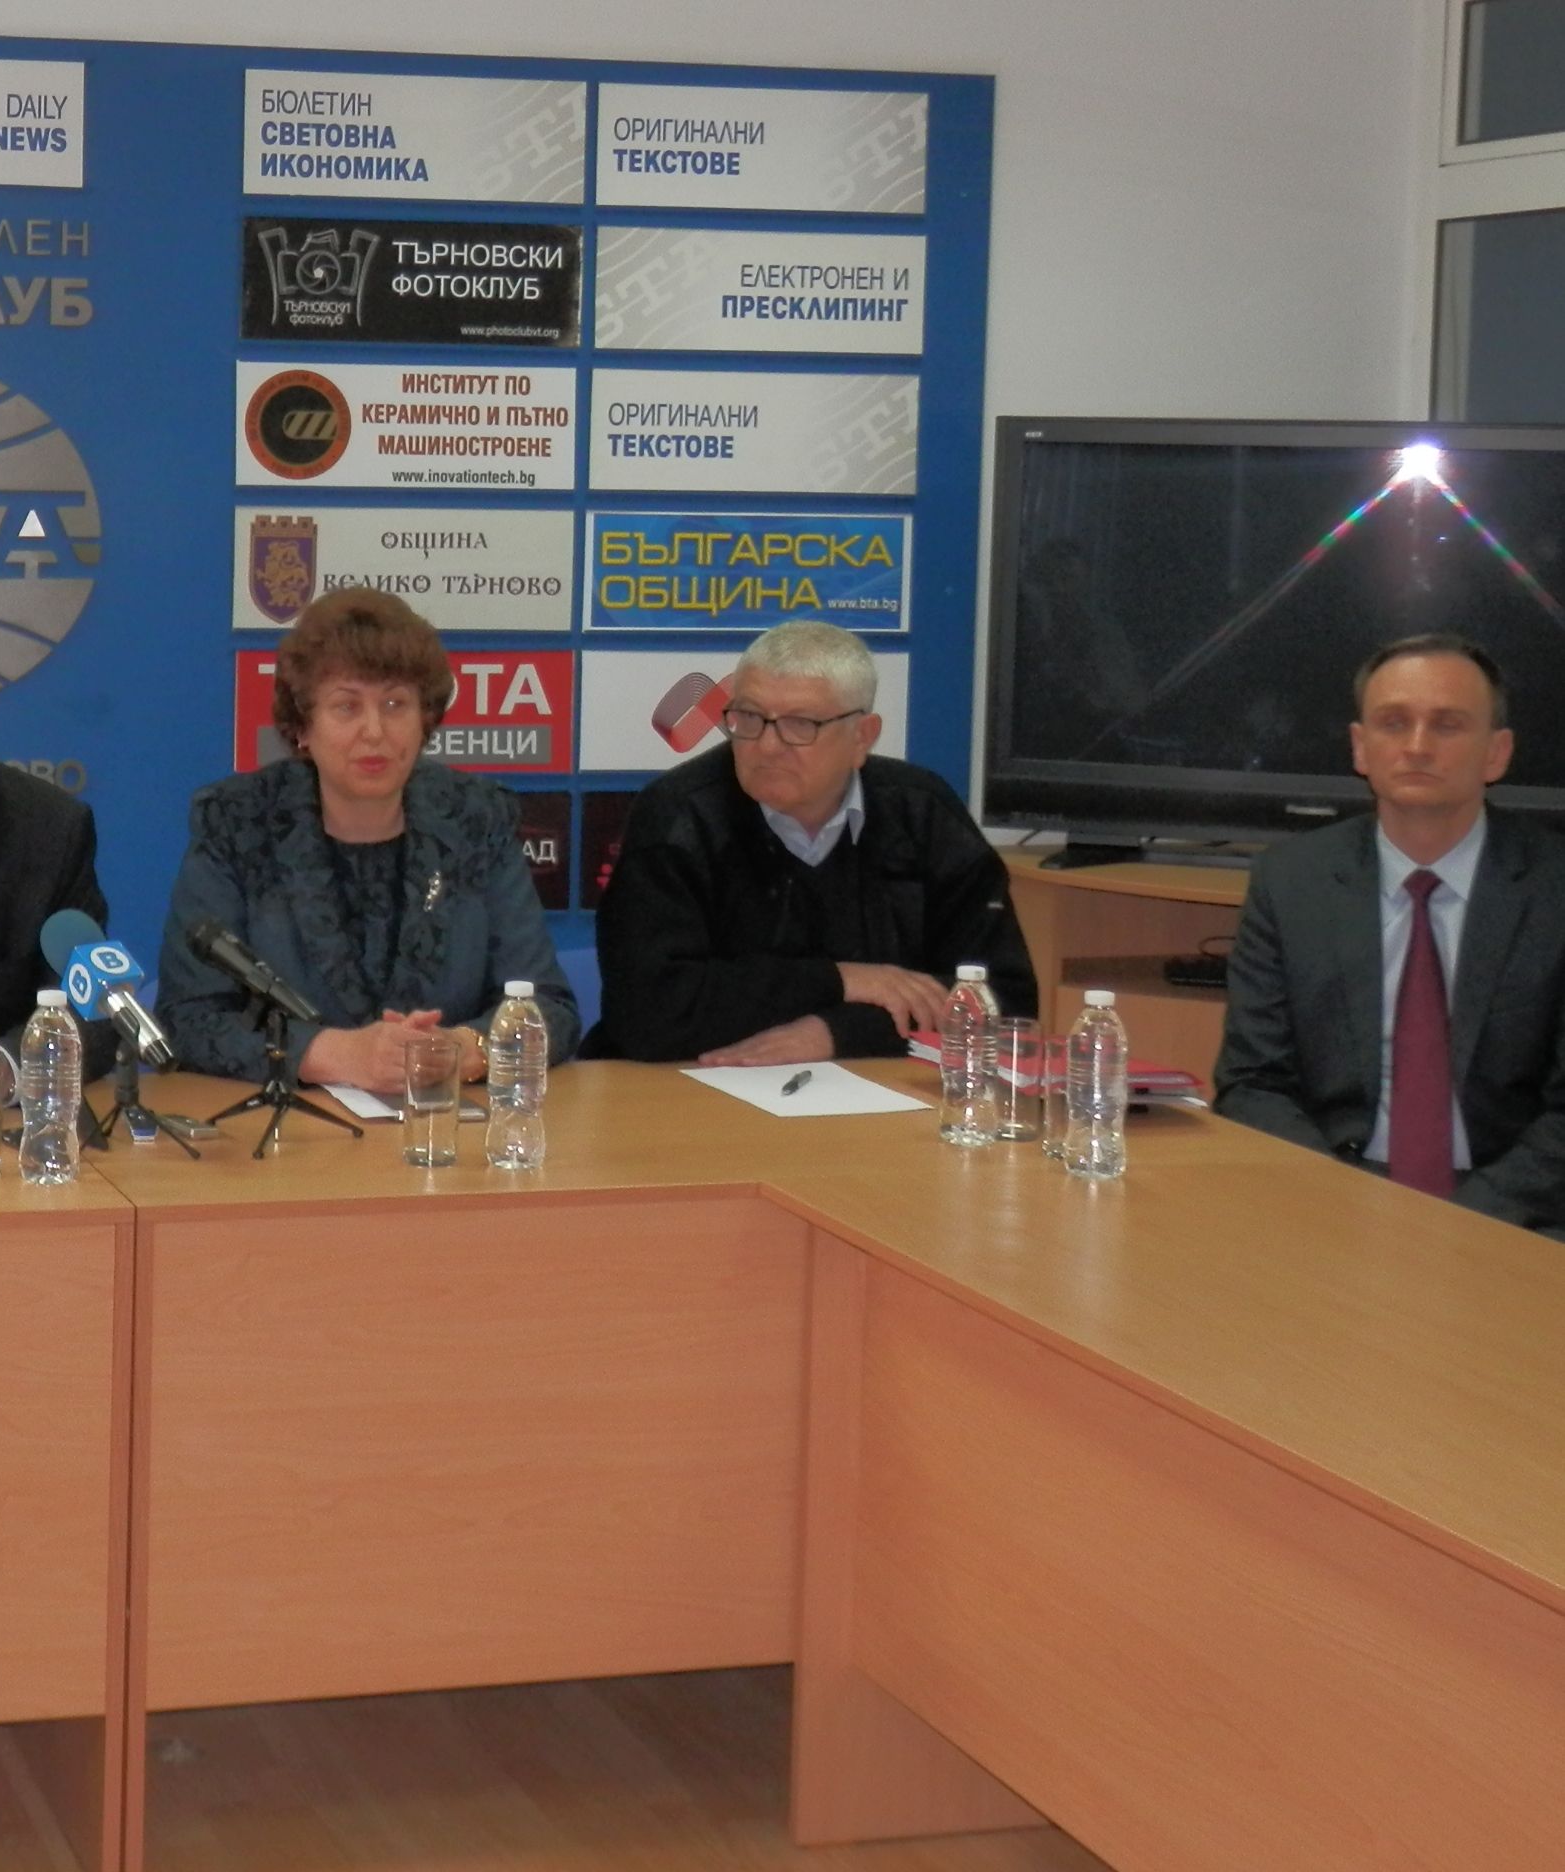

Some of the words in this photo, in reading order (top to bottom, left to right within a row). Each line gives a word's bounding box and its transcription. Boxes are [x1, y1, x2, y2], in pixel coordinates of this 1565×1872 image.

[7, 94, 67, 119] DAILY
[262, 89, 371, 116] БЮЛЕТИН
[261, 121, 396, 149] СВЕТОВНА
[614, 117, 764, 145] ОРИГИНАЛНИ
[261, 153, 428, 182] ИКОНОМИКА
[613, 149, 740, 175] ТЕКСТОВЕ
[392, 241, 563, 268] ТЪРНОВСКИ
[392, 274, 539, 300] ФОТОКЛУБ
[740, 264, 883, 290] ЕЛЕКТРОНЕН
[894, 268, 909, 290] И
[722, 295, 908, 321] ПРЕСКЛИПИНГ
[401, 373, 498, 395] ИНСТИТУТ
[505, 375, 531, 396] ПО
[362, 404, 480, 426] КЕРАМИЧНО
[487, 406, 500, 426] И
[506, 406, 569, 427] ПЪТНО
[608, 402, 758, 428] ОРИГИНАЛНИ
[378, 435, 552, 458] МАШИНОСТРОЕНЕ
[608, 434, 734, 458] ТЕКСТОВЕ
[392, 469, 535, 487] www.inovationtech.bg
[381, 531, 488, 559] ОБЩИНА
[600, 531, 894, 567] БЪЛГАРСКА
[442, 573, 562, 597] ТЪРНОВО
[600, 575, 823, 617] ОБЩИНА
[828, 598, 898, 611] www.bta.bg
